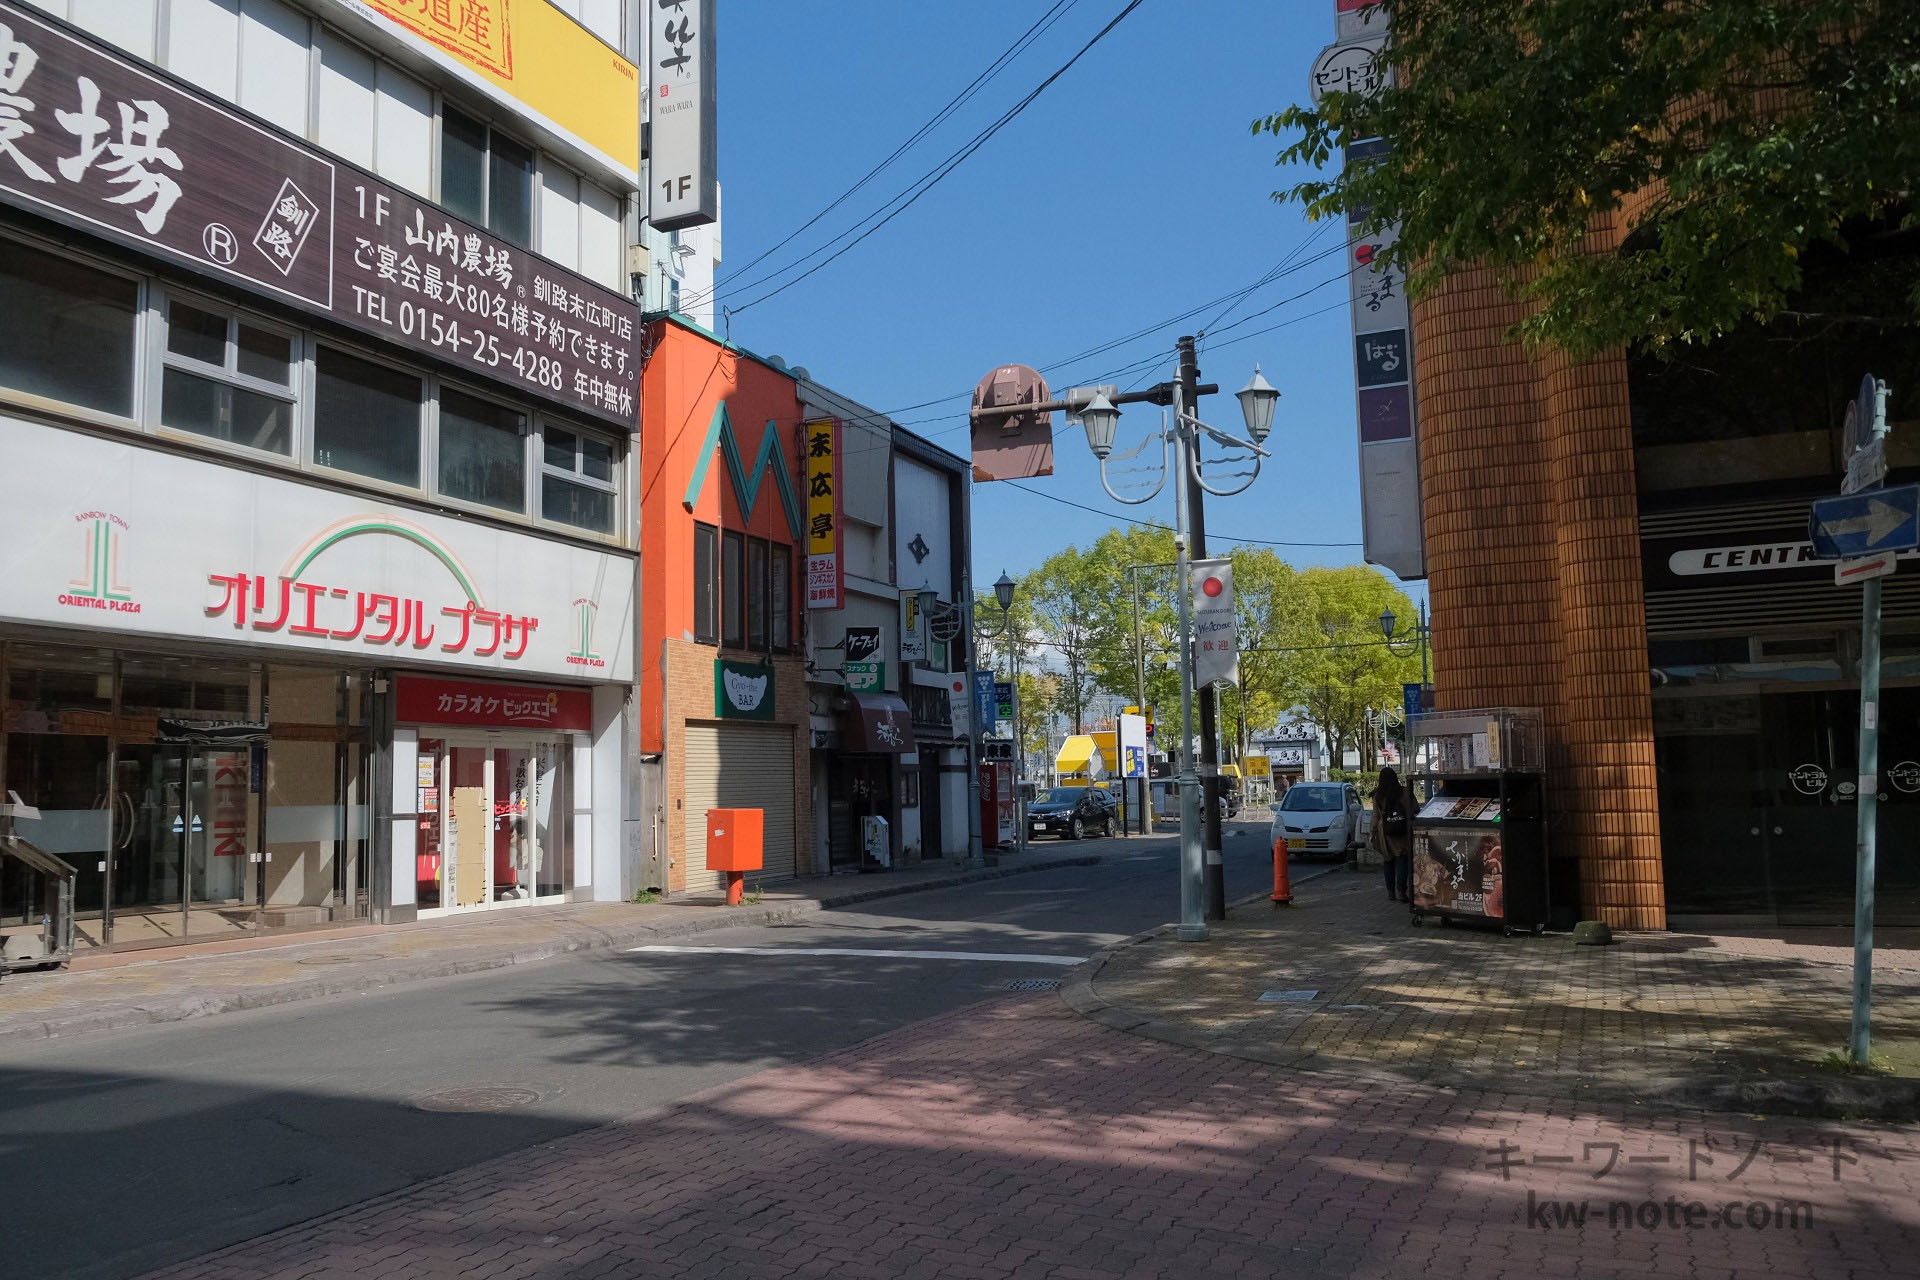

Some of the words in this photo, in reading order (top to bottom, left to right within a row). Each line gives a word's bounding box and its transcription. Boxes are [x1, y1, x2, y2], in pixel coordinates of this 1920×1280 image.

[612, 58, 634, 81] KIRIN
[662, 174, 691, 203] 1F
[262, 194, 309, 258] 釧路
[355, 185, 391, 227] 1F
[533, 274, 633, 341] 釧路末広町店
[353, 236, 634, 381] ご宴会最大80名様予約できます。
[352, 284, 393, 325] TEL
[399, 301, 563, 391] 0154-25-4288
[573, 368, 633, 418] 年中無休
[809, 432, 833, 539] 末広亭
[75, 510, 107, 523] RAINBOW
[109, 513, 130, 531] TOWN
[810, 560, 834, 571] 生ラム
[58, 594, 107, 610] ORIENTAL
[109, 599, 141, 614] PLAZA
[1198, 620, 1232, 634] Welcome
[1203, 639, 1229, 651] 歓迎
[437, 693, 500, 715] カラオケ
[503, 697, 558, 717] ビッグエコー
[739, 694, 754, 706] BAR
[1788, 771, 1828, 780] セントラル
[214, 758, 247, 857] KIIN
[1446, 841, 1465, 890] さかまる
